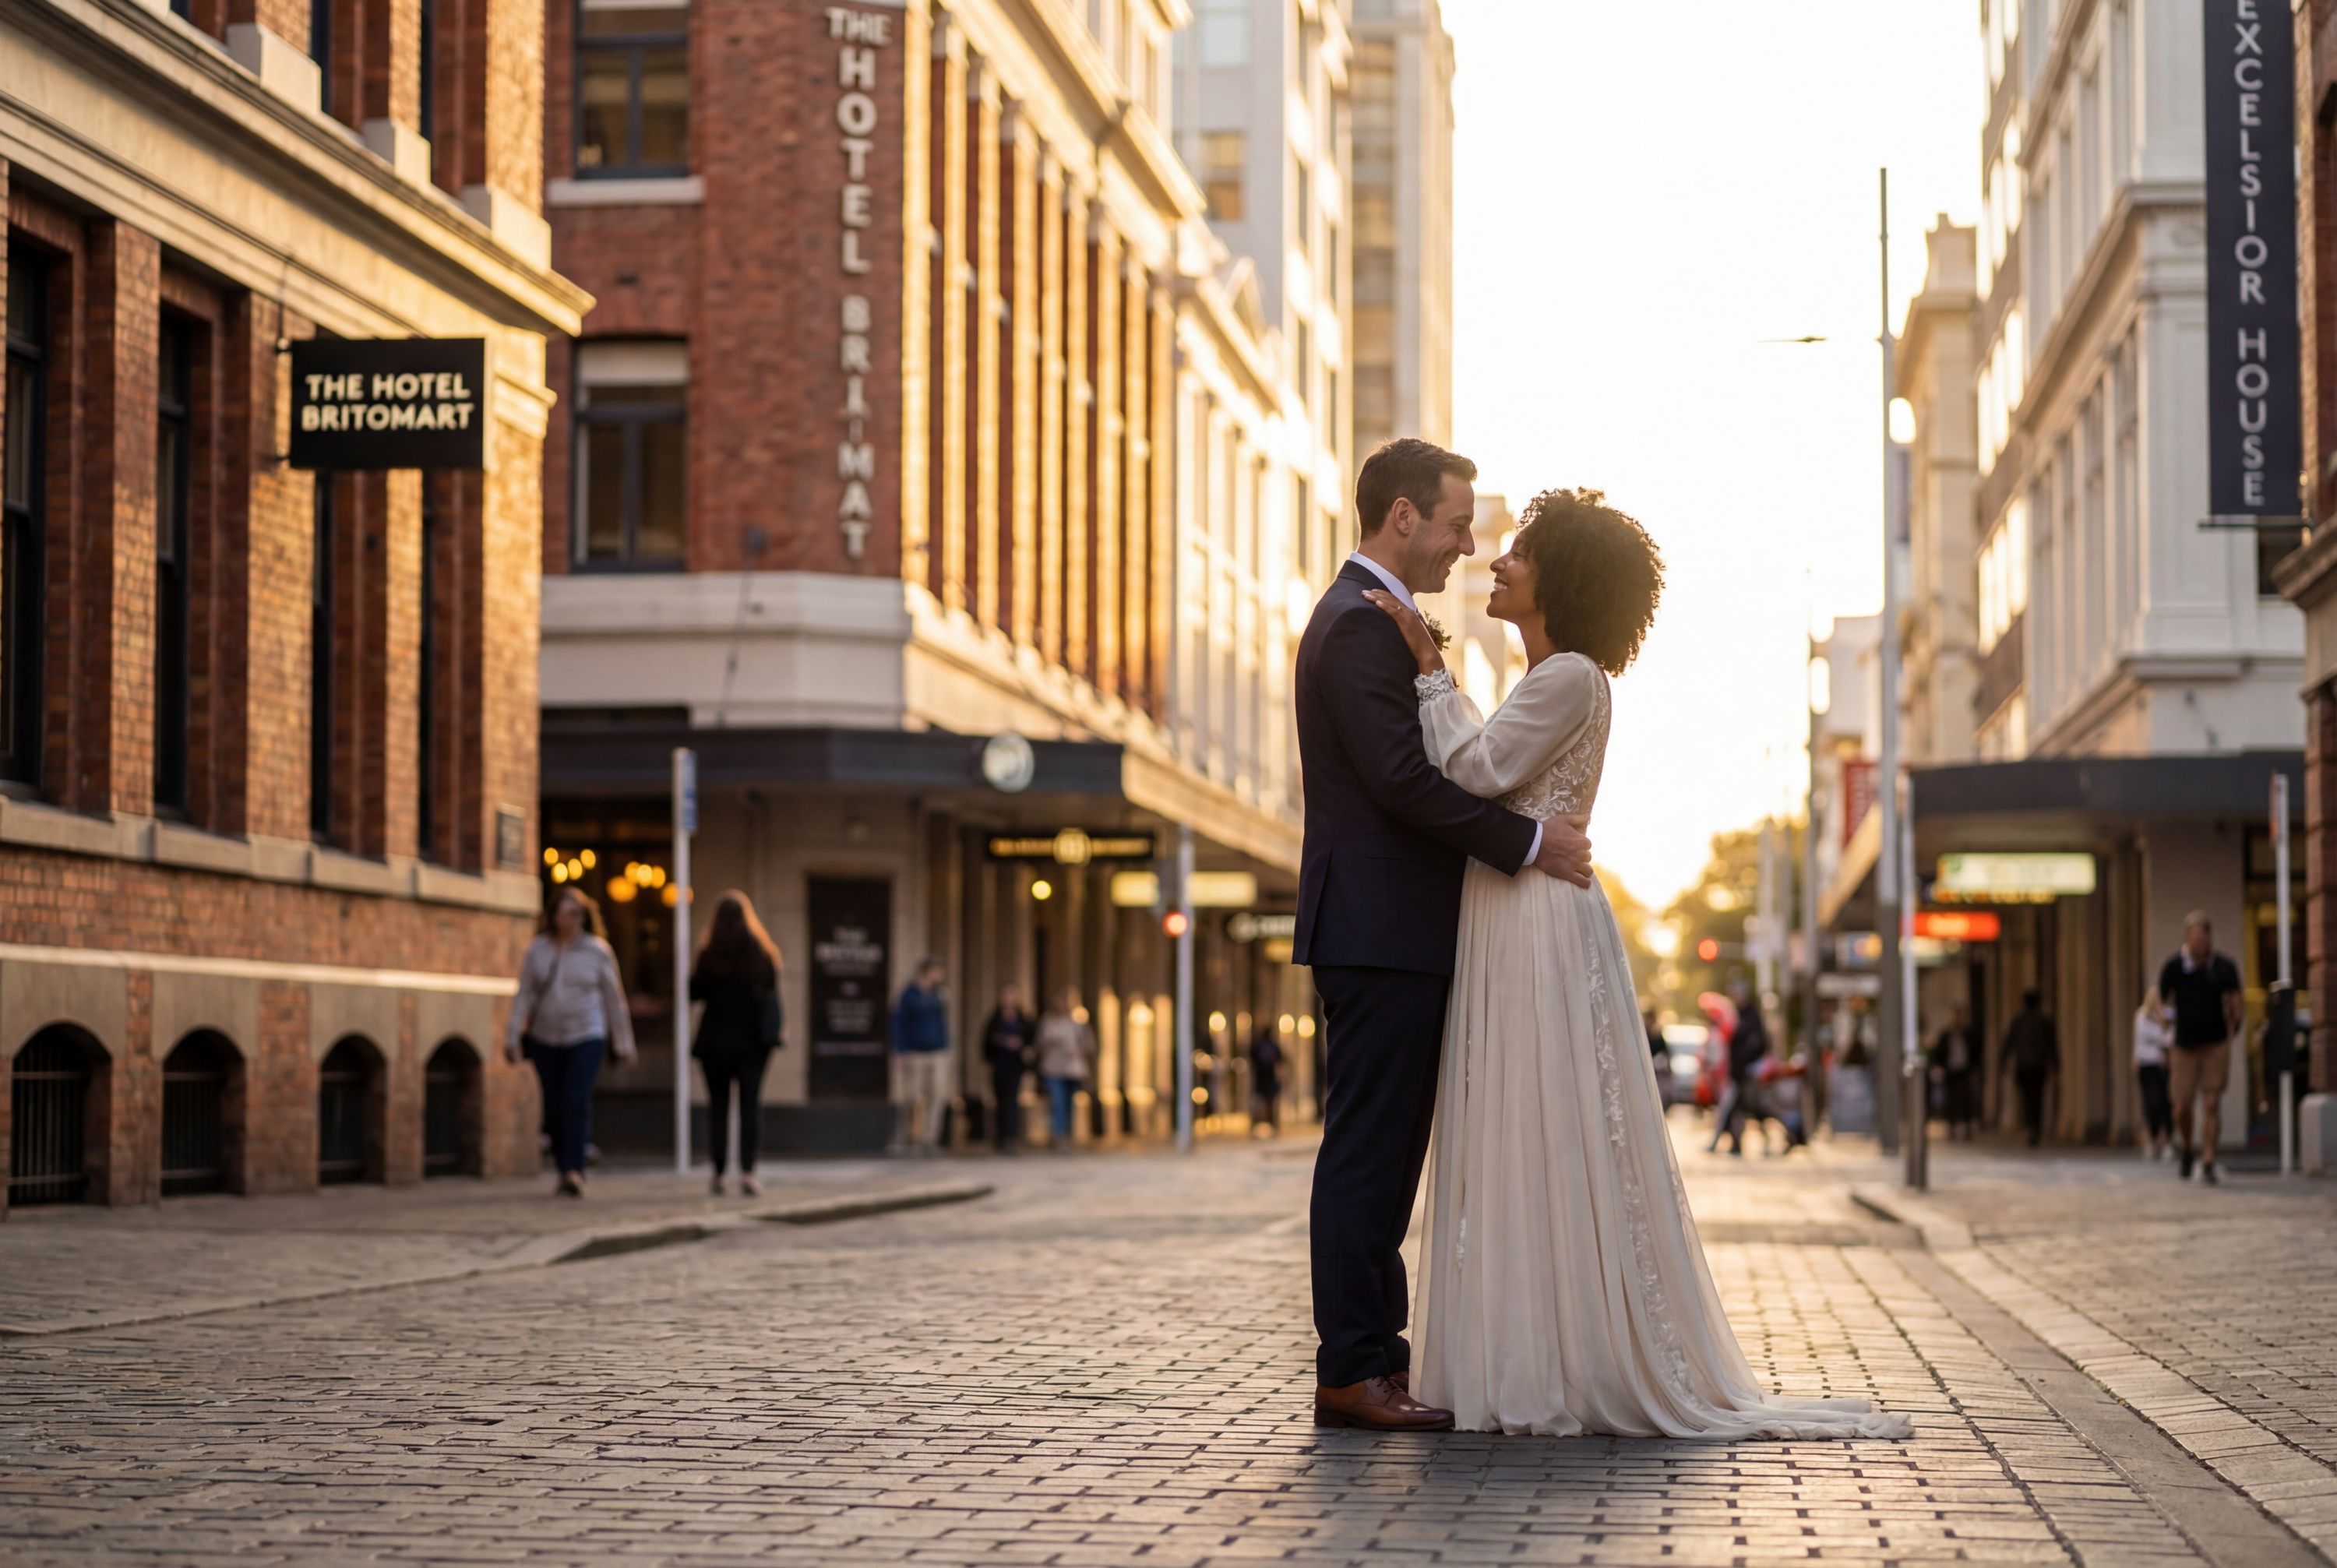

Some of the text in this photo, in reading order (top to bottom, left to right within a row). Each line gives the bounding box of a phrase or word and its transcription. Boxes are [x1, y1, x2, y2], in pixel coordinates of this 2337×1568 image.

[825, 6, 893, 46] THE
[837, 46, 877, 274] HOTEL
[2233, 0, 2270, 506] EXCELSIOR HOUSE
[305, 373, 471, 400] THE HOTEL
[301, 403, 474, 432] BRITOMART
